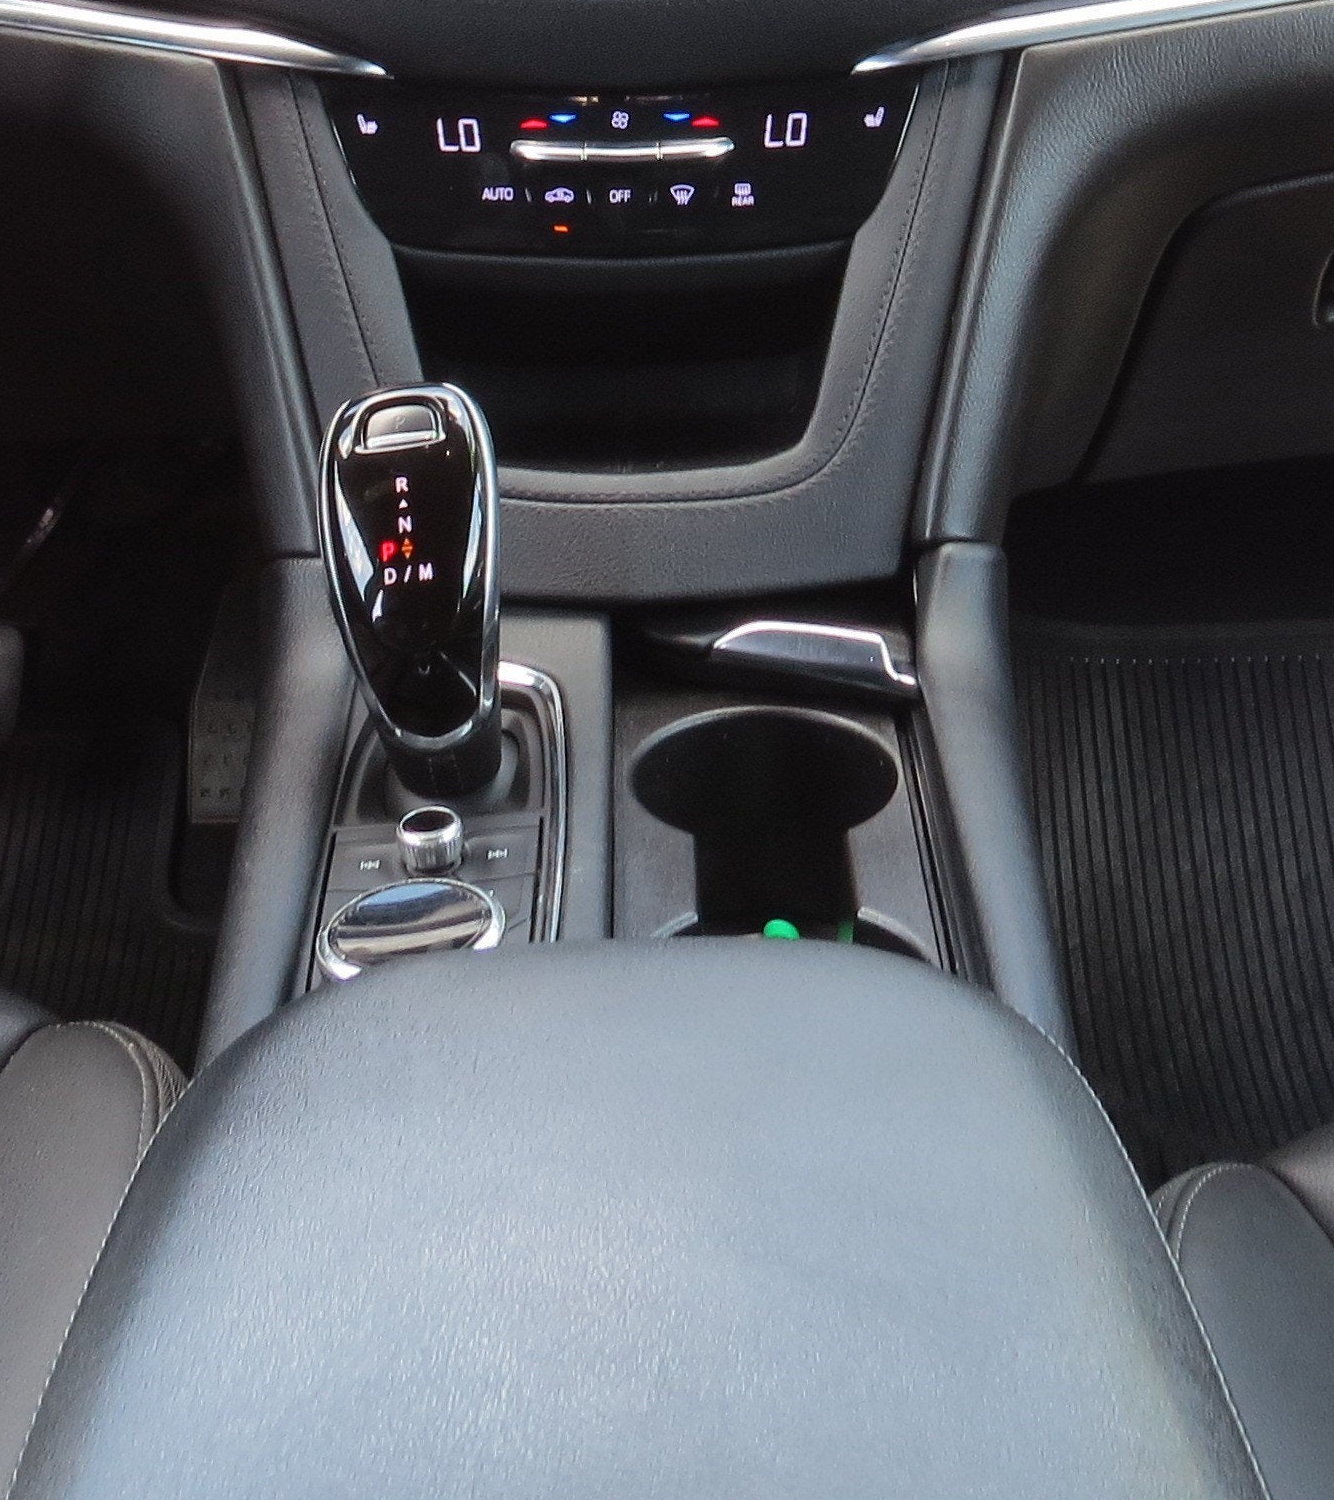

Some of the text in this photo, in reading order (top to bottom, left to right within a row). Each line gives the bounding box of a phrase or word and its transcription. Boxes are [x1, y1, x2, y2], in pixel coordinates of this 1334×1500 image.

[482, 187, 514, 202] AUTO
[608, 188, 632, 204] OFF
[731, 195, 755, 207] REAR
[395, 476, 409, 493] R
[398, 516, 413, 534] N
[380, 541, 396, 562] P
[383, 567, 397, 586] D
[419, 563, 434, 581] M
